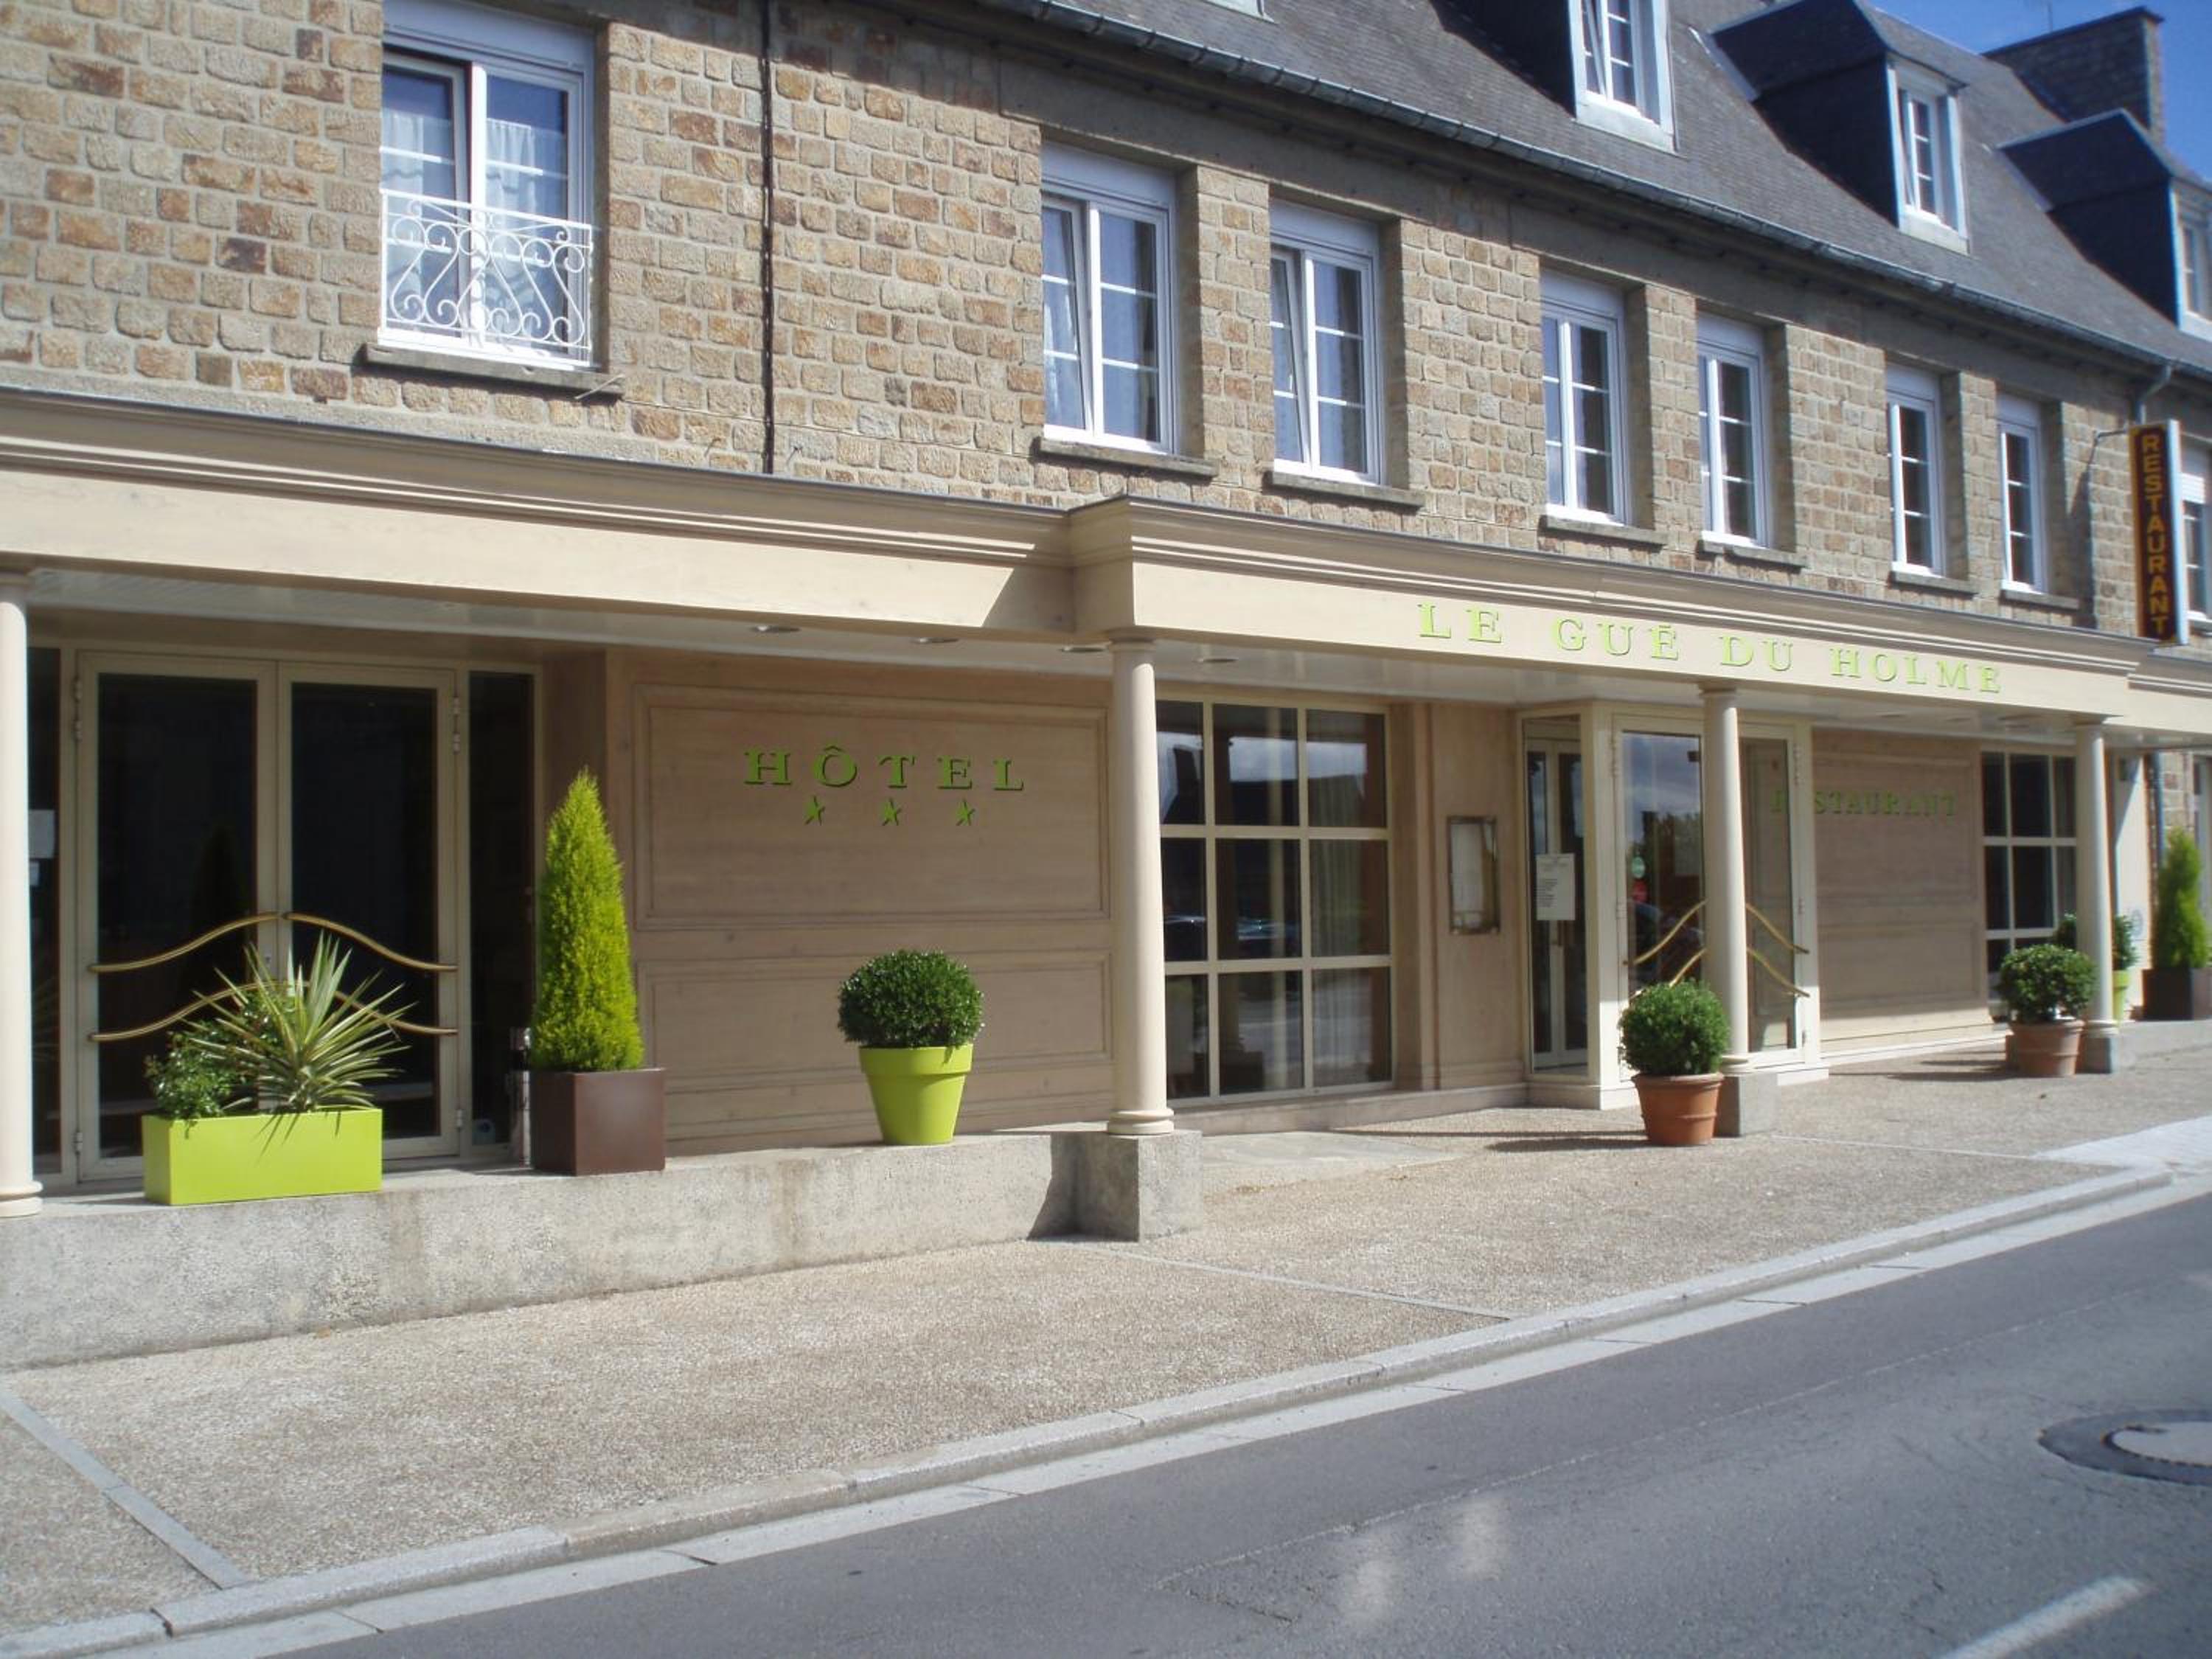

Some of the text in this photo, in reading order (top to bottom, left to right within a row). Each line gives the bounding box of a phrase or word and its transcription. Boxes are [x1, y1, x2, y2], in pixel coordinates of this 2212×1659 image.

[2141, 434, 2169, 635] RESTAURANT
[1417, 601, 1502, 644] LE
[1719, 636, 1794, 672] DU
[1830, 647, 2001, 693] HOLME
[744, 745, 1025, 791] HÔTEL
